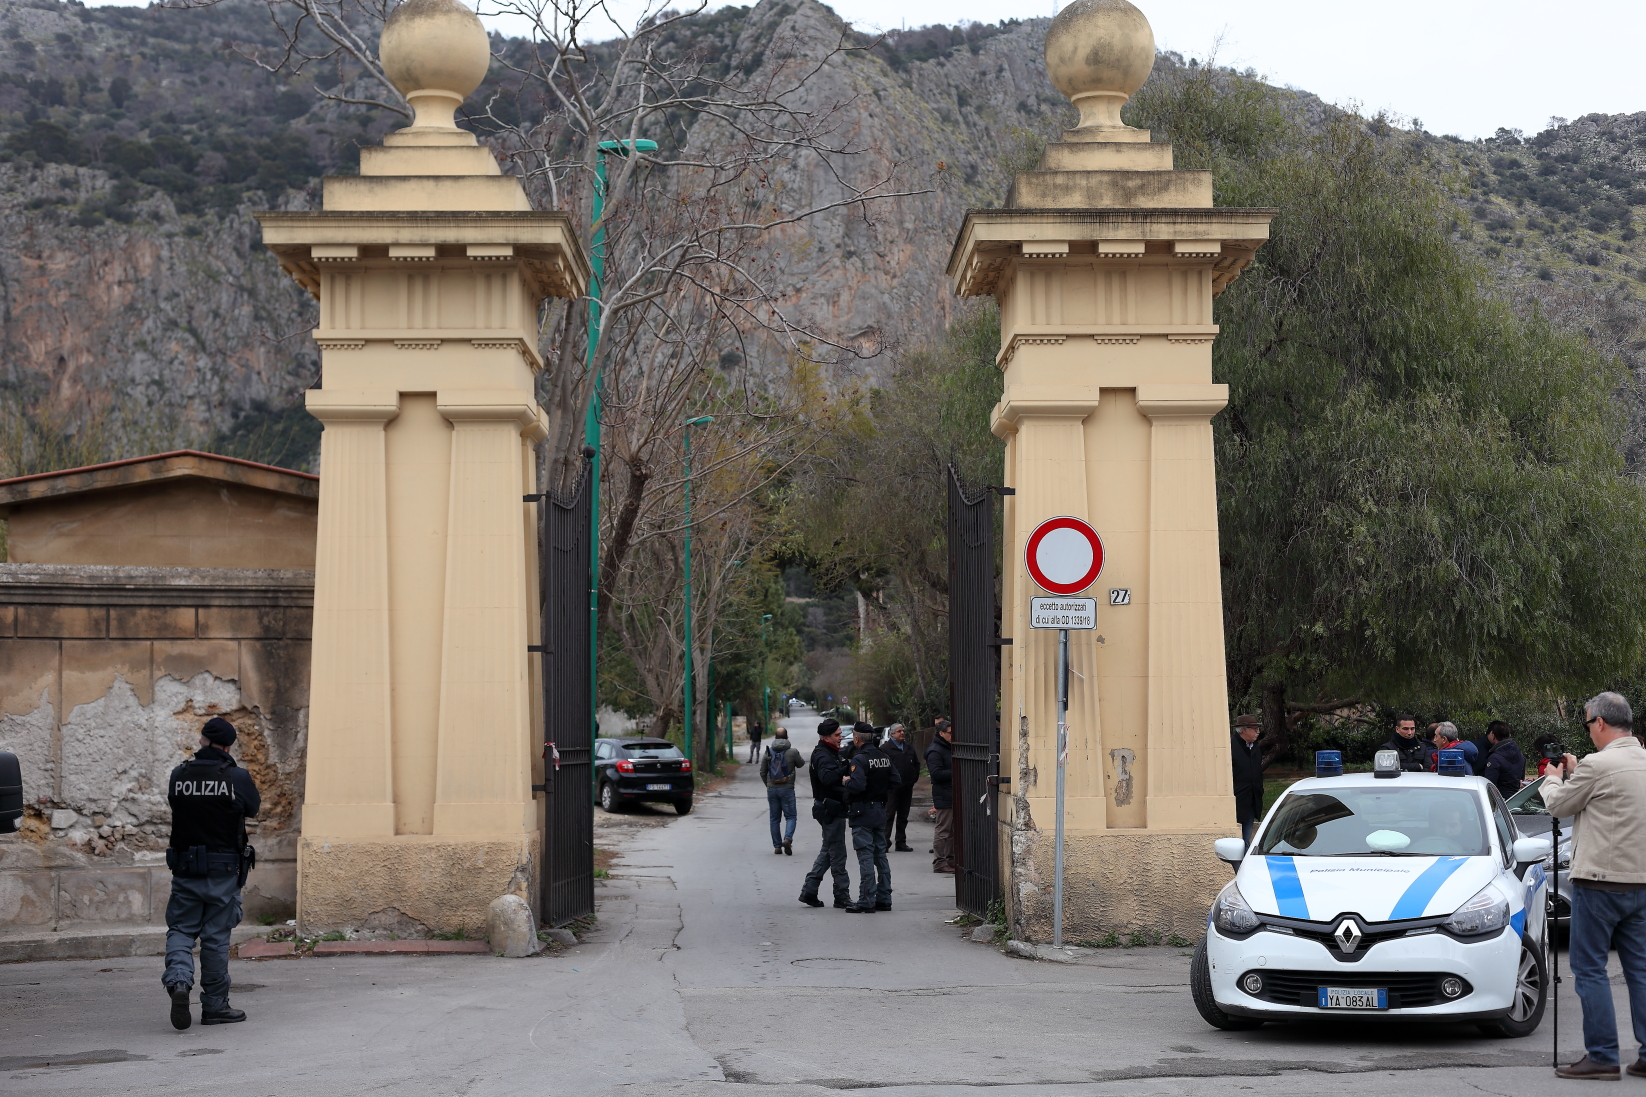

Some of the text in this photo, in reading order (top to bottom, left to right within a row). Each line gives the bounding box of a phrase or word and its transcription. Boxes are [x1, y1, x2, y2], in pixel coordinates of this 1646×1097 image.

[1112, 589, 1128, 603] 27
[1040, 602, 1087, 611] eccetto autorizzati
[1035, 615, 1040, 624] di
[1041, 615, 1050, 624] cui
[1051, 615, 1060, 624] alla
[1061, 615, 1070, 624] OD
[175, 781, 229, 796] POLIZIA
